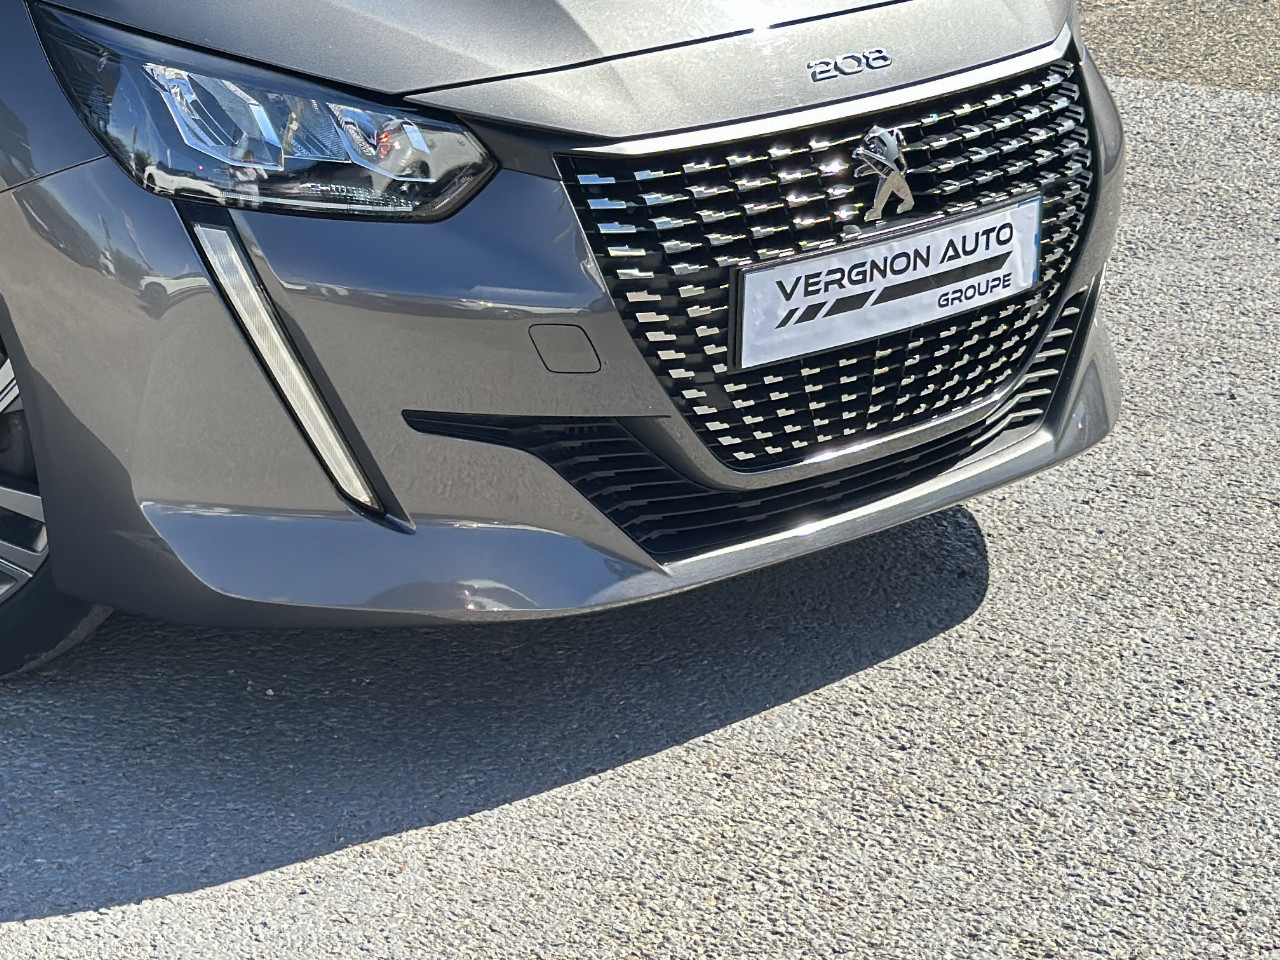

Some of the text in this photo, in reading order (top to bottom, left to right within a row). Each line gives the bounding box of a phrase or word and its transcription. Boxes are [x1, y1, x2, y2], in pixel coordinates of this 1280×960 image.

[806, 47, 893, 83] 208
[775, 222, 1014, 302] VERGNON AUTO
[937, 272, 1013, 308] GROUPE
